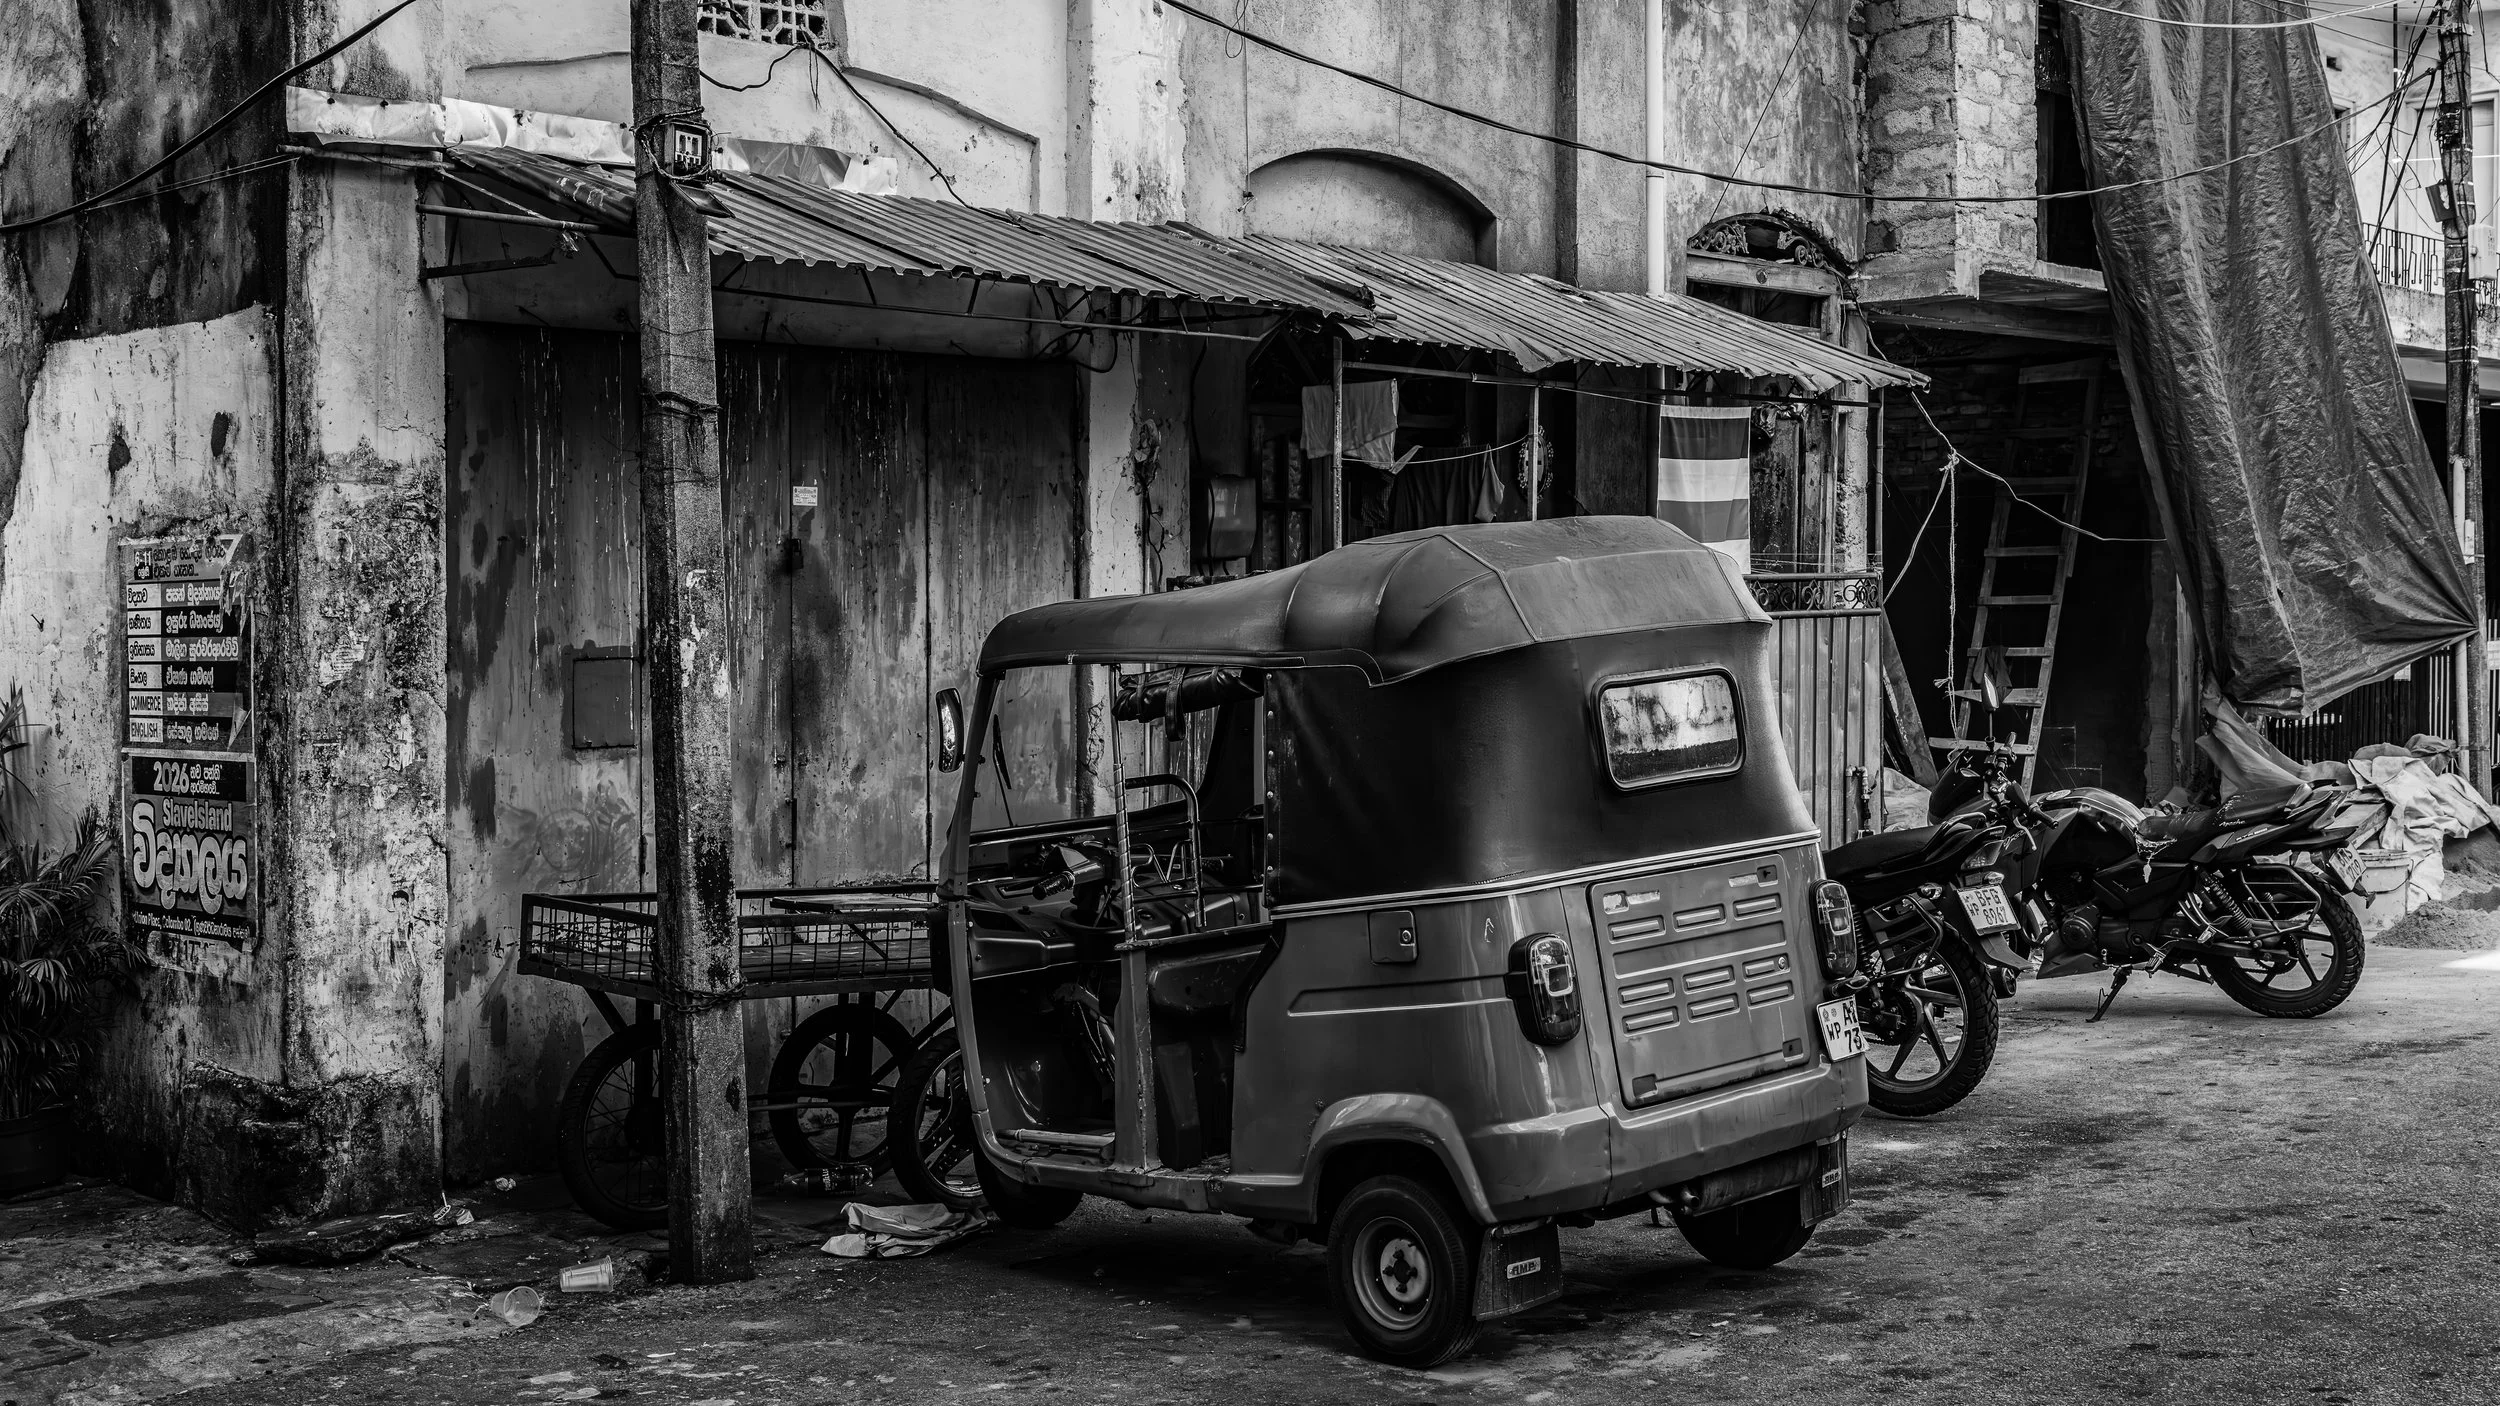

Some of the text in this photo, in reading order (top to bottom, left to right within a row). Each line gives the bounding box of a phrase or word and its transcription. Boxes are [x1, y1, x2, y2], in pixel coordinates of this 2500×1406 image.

[130, 695, 161, 711] COMMERCE
[131, 722, 158, 738] ENGLISH
[153, 761, 190, 794] 2026
[162, 798, 232, 832] SlaveIsland
[1974, 888, 2002, 907] BFG
[1826, 1021, 1841, 1041] WP
